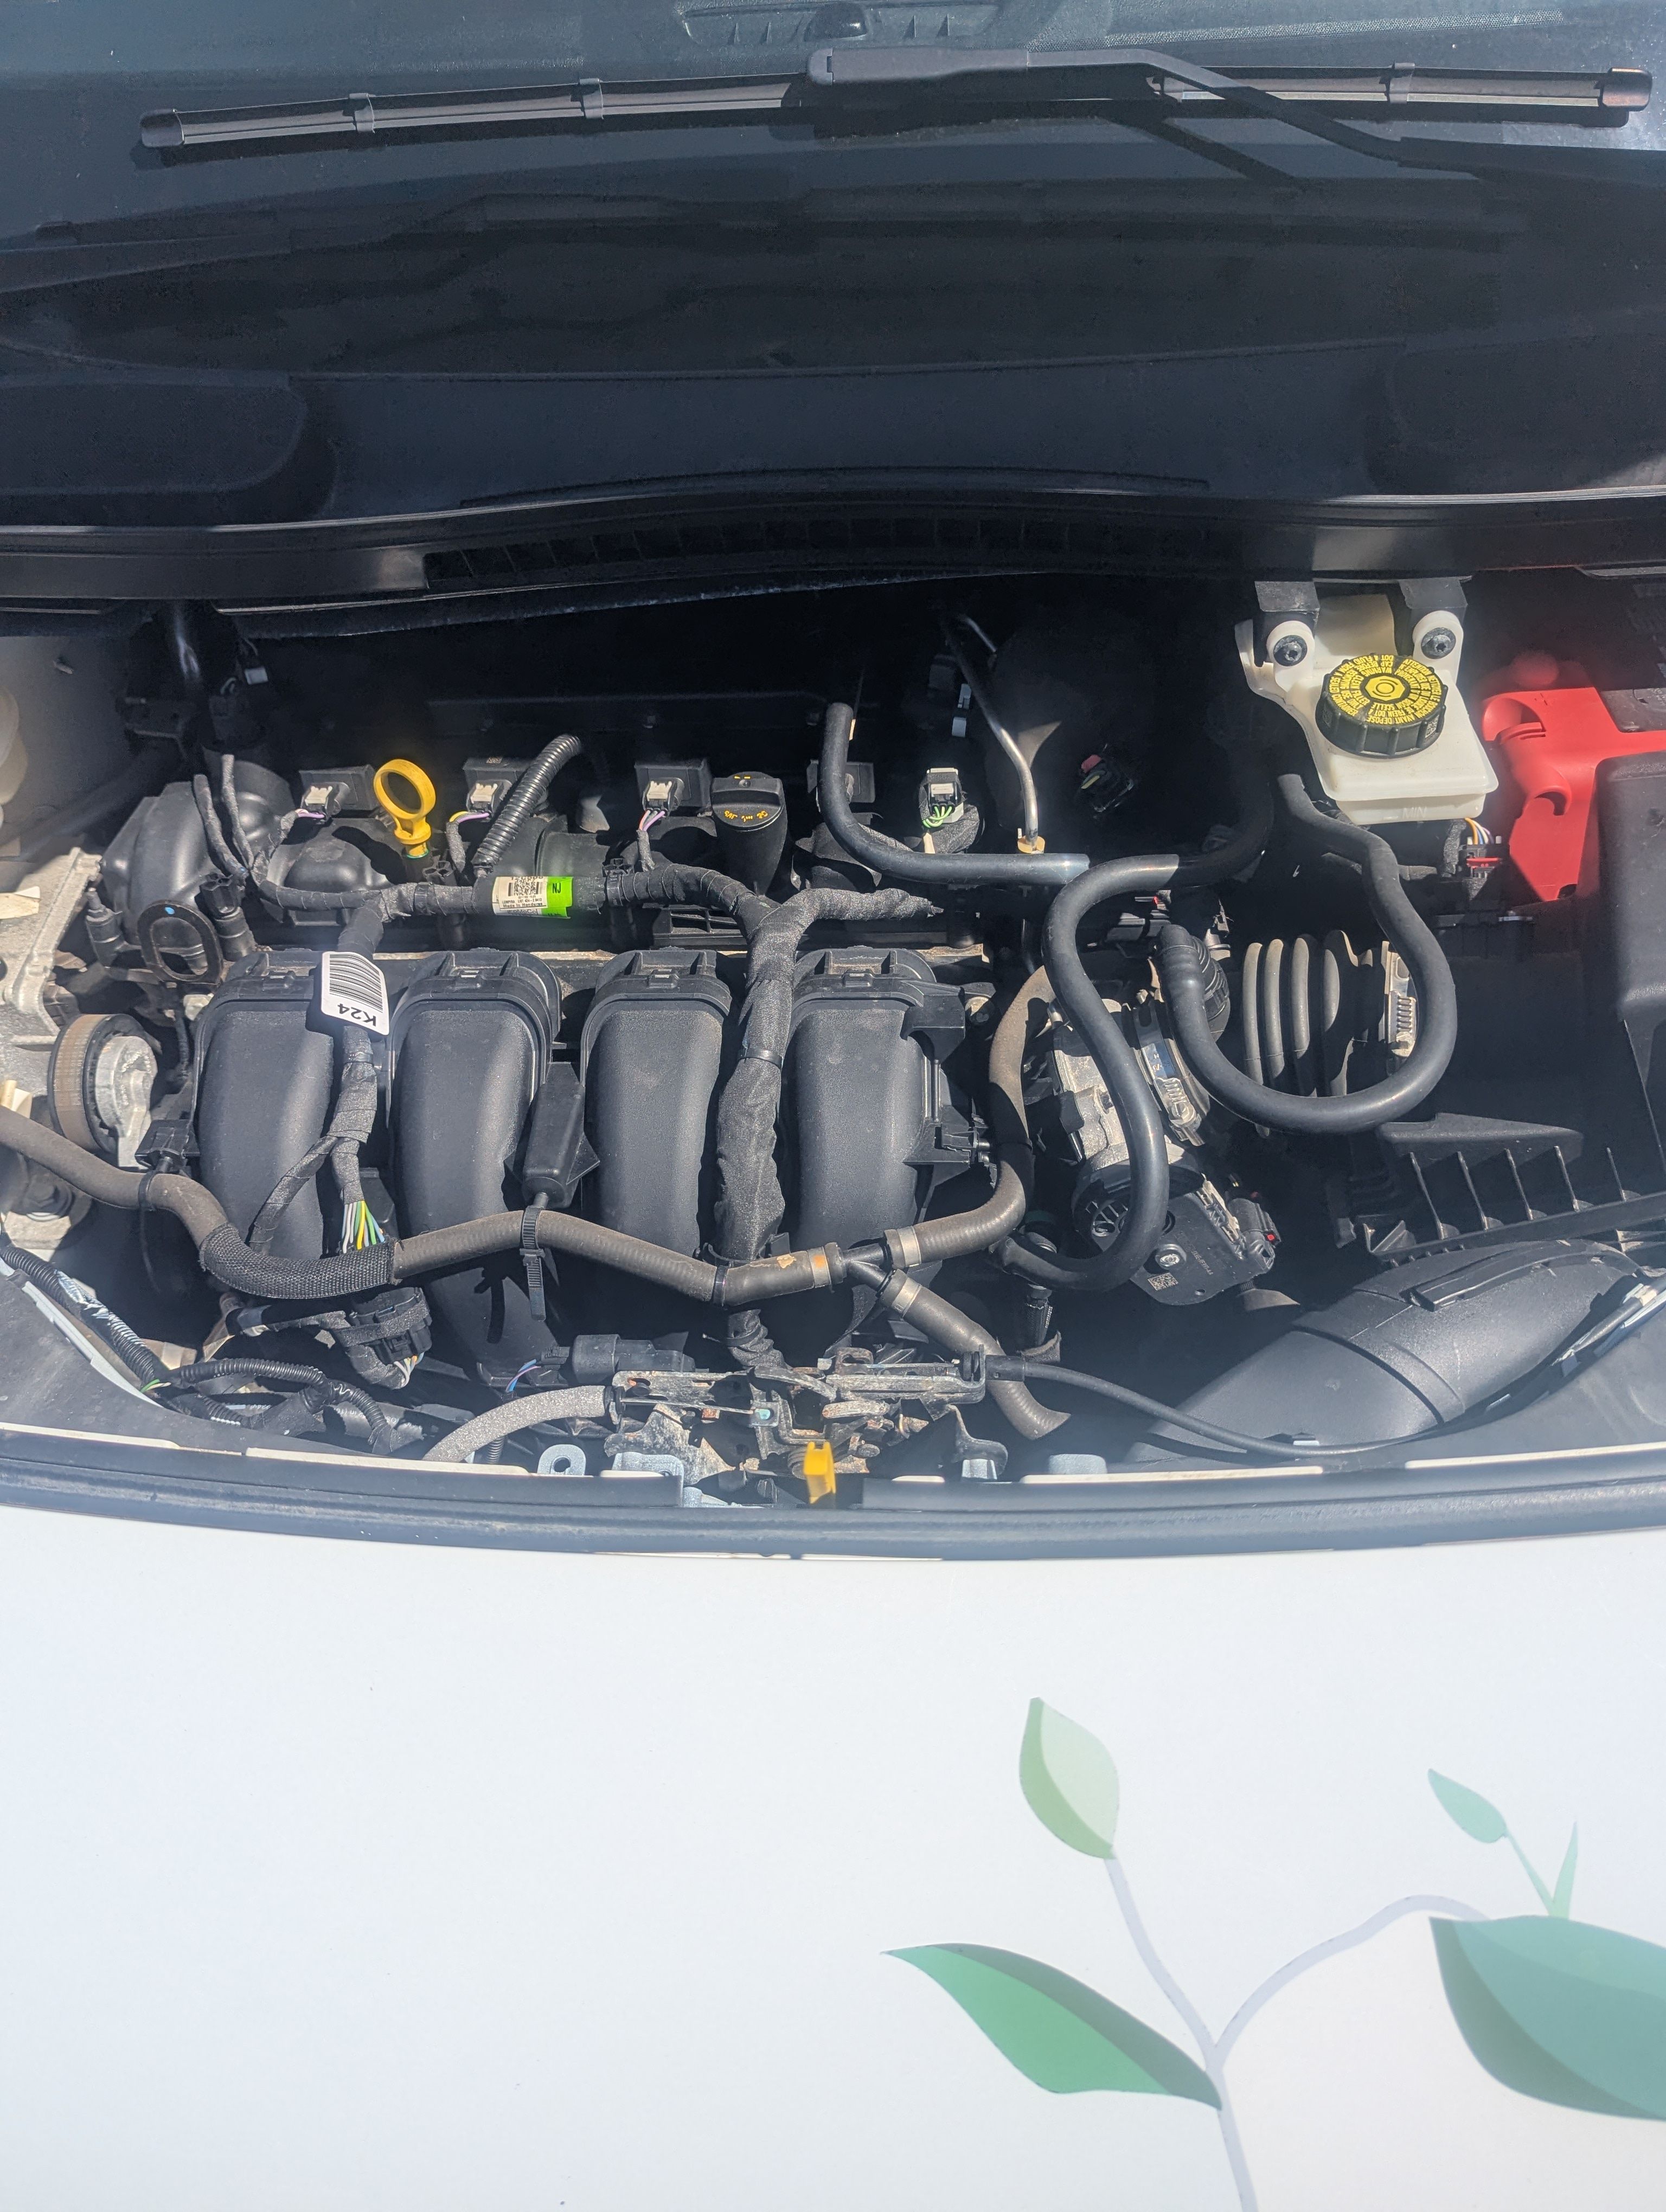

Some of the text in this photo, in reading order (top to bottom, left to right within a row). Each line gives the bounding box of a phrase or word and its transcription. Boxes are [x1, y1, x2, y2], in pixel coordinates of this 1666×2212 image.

[1354, 656, 1373, 665] FLUID
[1357, 660, 1379, 672] BEFORE
[1338, 662, 1355, 673] FROM
[1361, 667, 1392, 677] WARNING
[1403, 659, 1432, 676] ATTENTION
[1330, 677, 1341, 693] SEALED
[1351, 675, 1364, 689] CLEAN
[1341, 690, 1352, 698] USE
[1331, 695, 1358, 716] CONTAINER
[1348, 697, 1363, 710] ONLY
[1372, 702, 1394, 710] SCELLE
[1415, 700, 1438, 718] BOUCHON
[1367, 716, 1392, 724] DEPOSE
[1395, 716, 1415, 724] AVANT
[1402, 806, 1427, 819] MIN
[552, 883, 561, 893] NJ
[337, 1003, 376, 1027] K24
